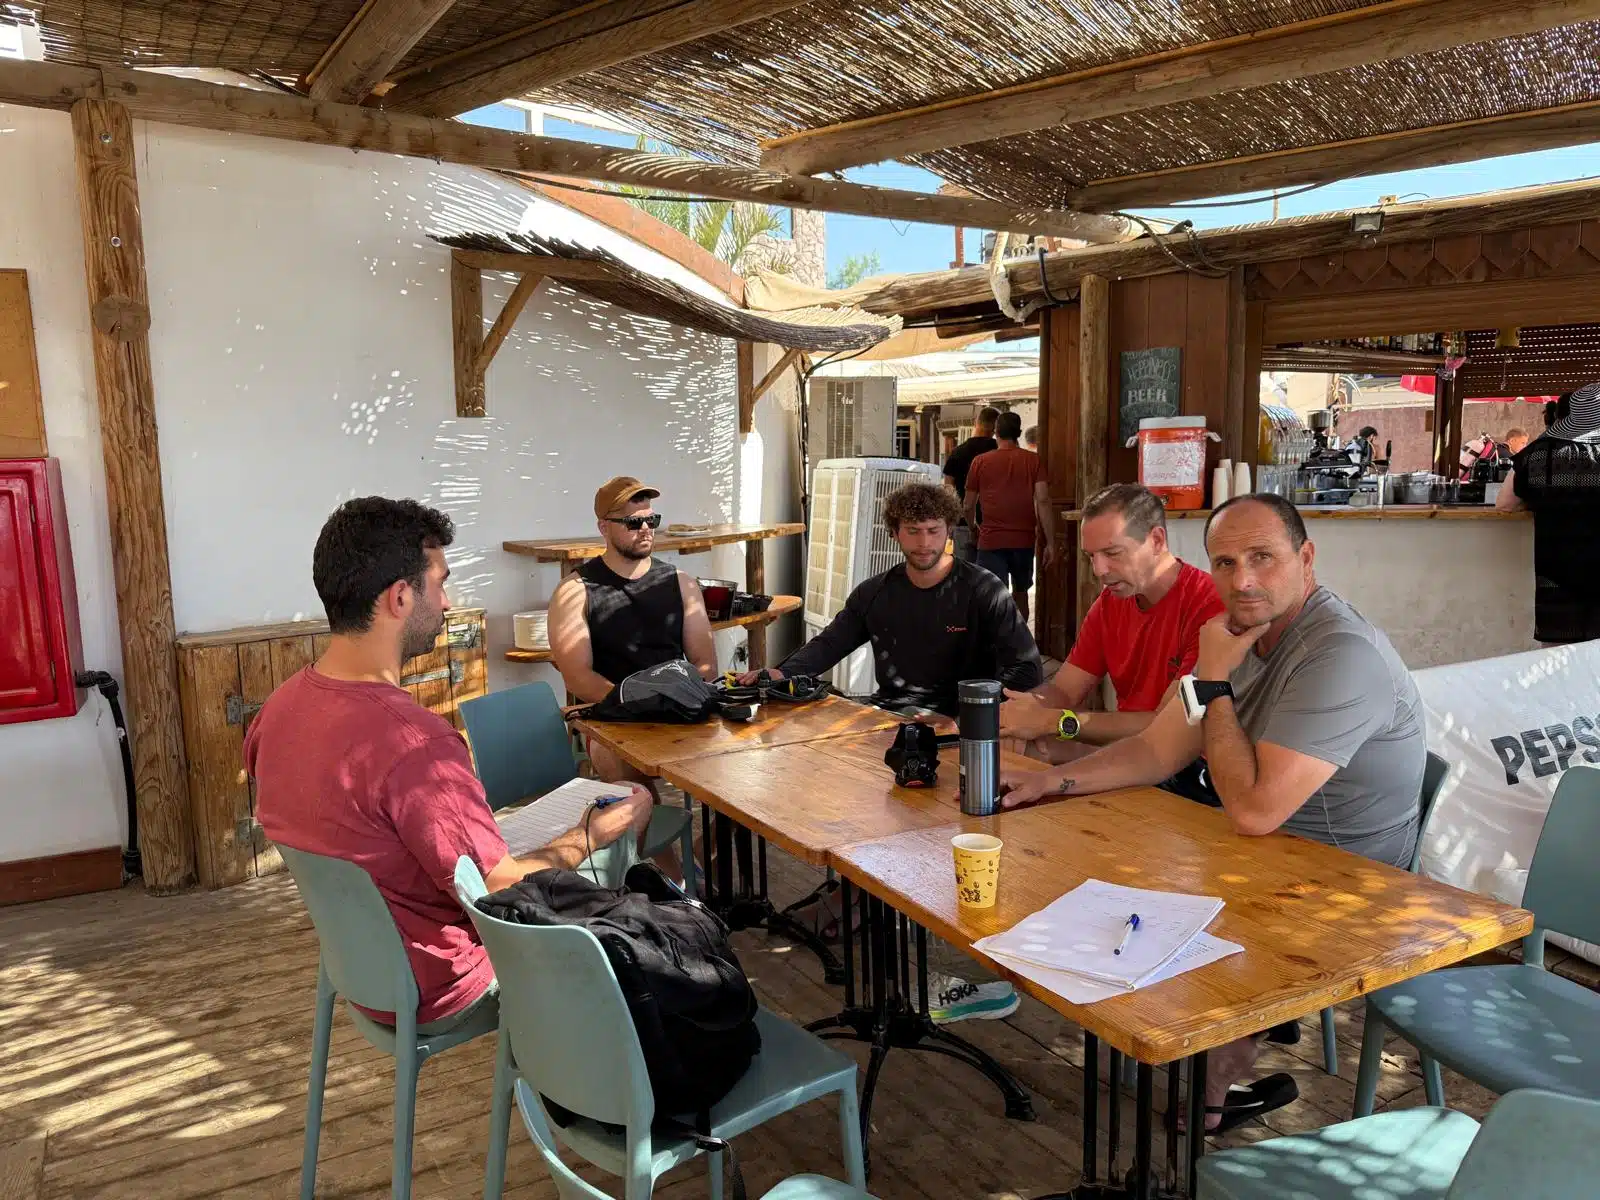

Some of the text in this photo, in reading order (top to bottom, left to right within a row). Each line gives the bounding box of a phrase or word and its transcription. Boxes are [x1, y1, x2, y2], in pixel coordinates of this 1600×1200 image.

[1127, 388, 1167, 404] BEER
[1490, 713, 1600, 786] PEPS
[938, 983, 979, 1006] HOKA
